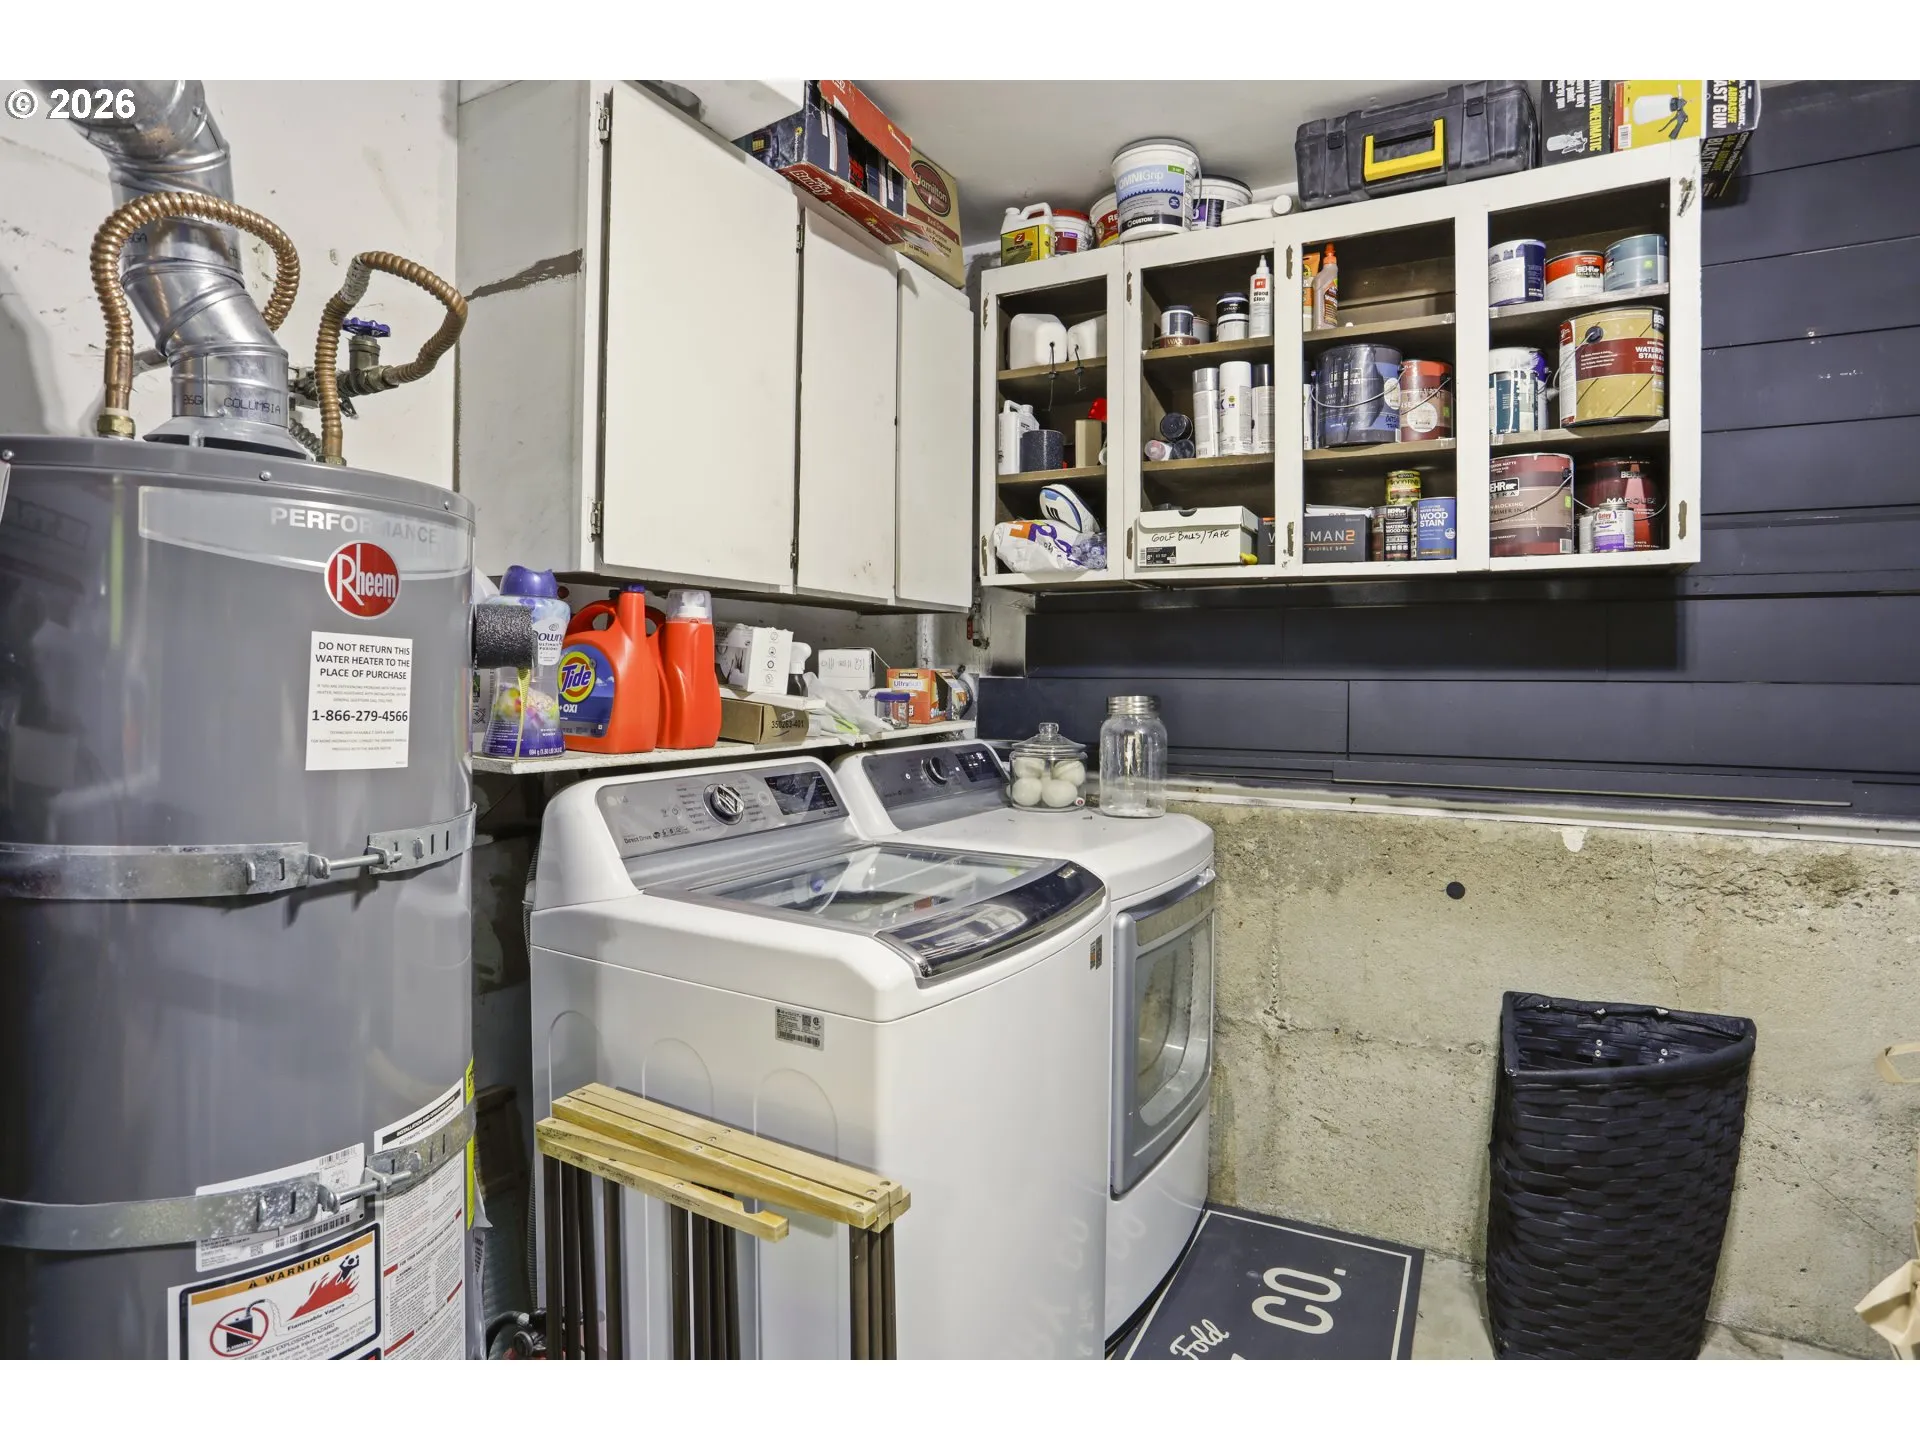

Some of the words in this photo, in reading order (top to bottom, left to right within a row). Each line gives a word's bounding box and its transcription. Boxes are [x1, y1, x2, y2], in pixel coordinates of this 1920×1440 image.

[1712, 104, 1728, 129] GUN
[1728, 87, 1738, 123] ABRASIVE
[792, 169, 833, 197] Buddy
[1420, 511, 1449, 520] WOOD
[1420, 519, 1445, 528] STAIN
[336, 543, 397, 606] Rheem
[315, 654, 350, 664] WATER
[351, 656, 384, 666] HEATER
[386, 658, 396, 667] TO
[397, 659, 410, 668] THE
[318, 641, 334, 651] DO
[336, 643, 357, 652] NOT
[359, 644, 393, 655] RETURN
[394, 646, 410, 656] THIS
[320, 668, 349, 678] PLACE
[351, 669, 364, 678] OF
[366, 670, 407, 680] PURCHASE
[561, 663, 592, 693] Tide
[311, 709, 408, 722] 1-866-279-4566
[265, 1253, 332, 1284] WARNING
[1252, 1267, 1347, 1335] CO.
[287, 1313, 323, 1331] Flammable
[324, 1303, 345, 1316] Vapors
[276, 1334, 310, 1351] EXPLOSION
[311, 1322, 336, 1339] HAZARD
[1169, 1318, 1230, 1360] Fold
